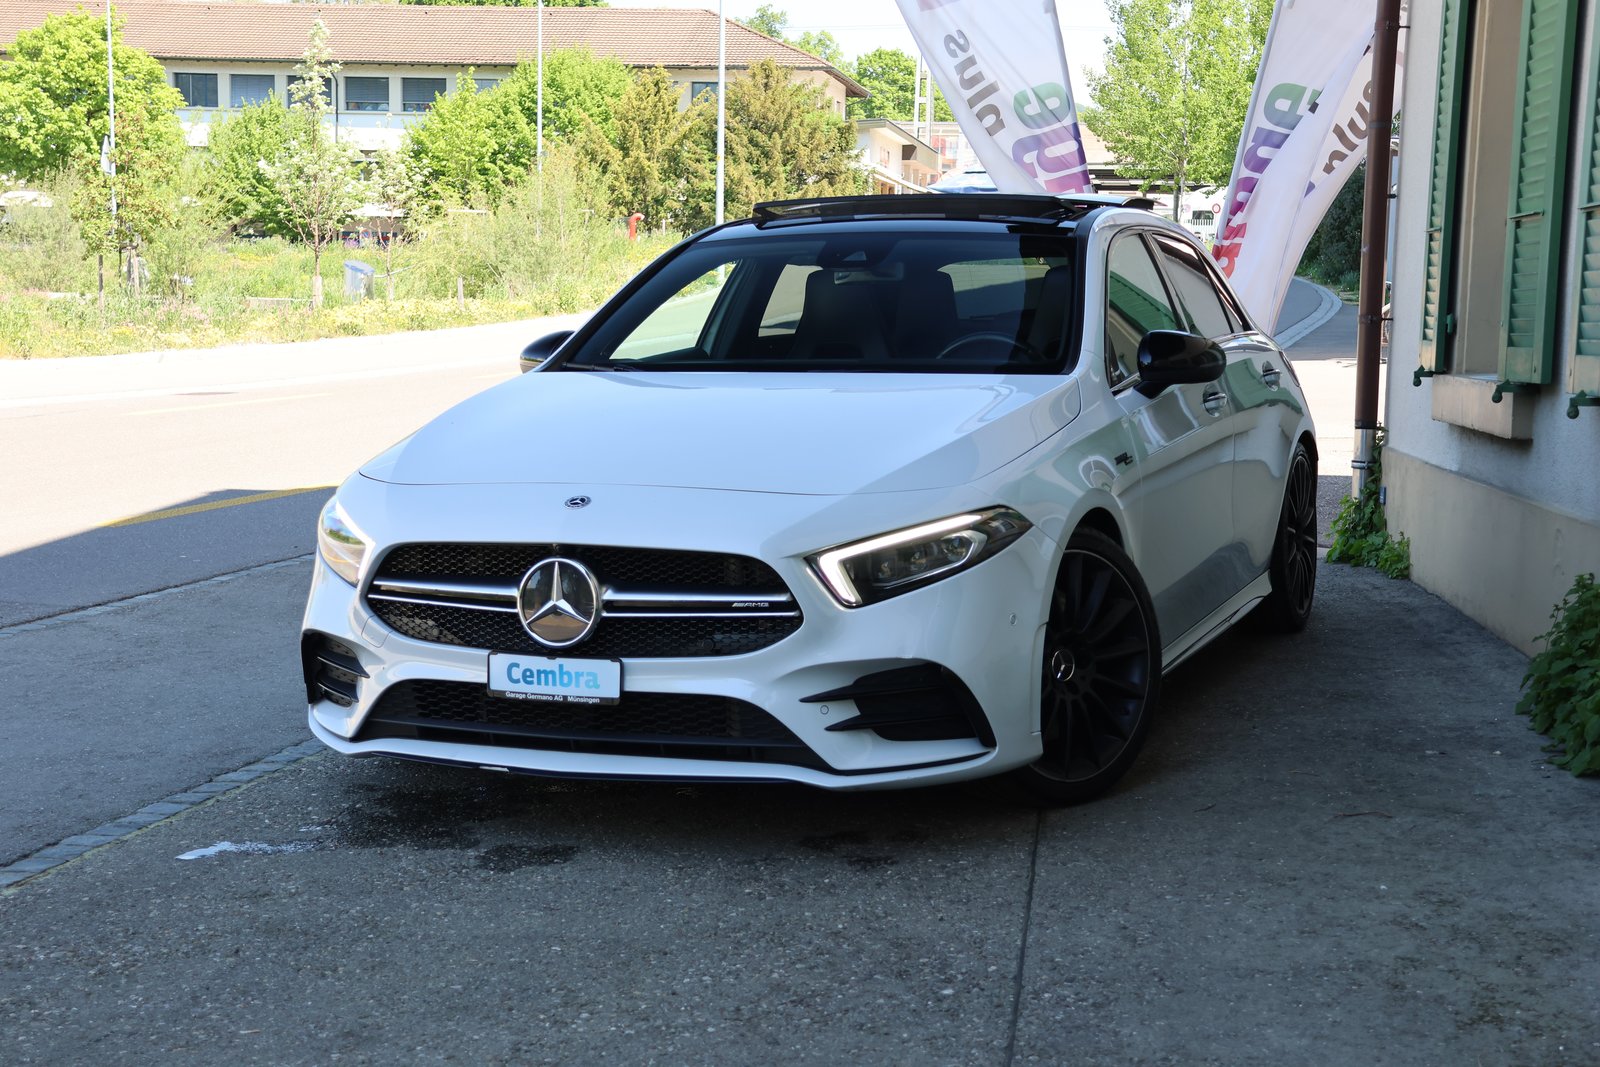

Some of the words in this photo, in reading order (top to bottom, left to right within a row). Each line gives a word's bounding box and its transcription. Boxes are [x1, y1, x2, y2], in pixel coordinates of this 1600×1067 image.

[506, 662, 600, 690] Cembra
[505, 691, 526, 700] Garage
[527, 693, 553, 701] Germano
[567, 696, 600, 704] Münsingen
